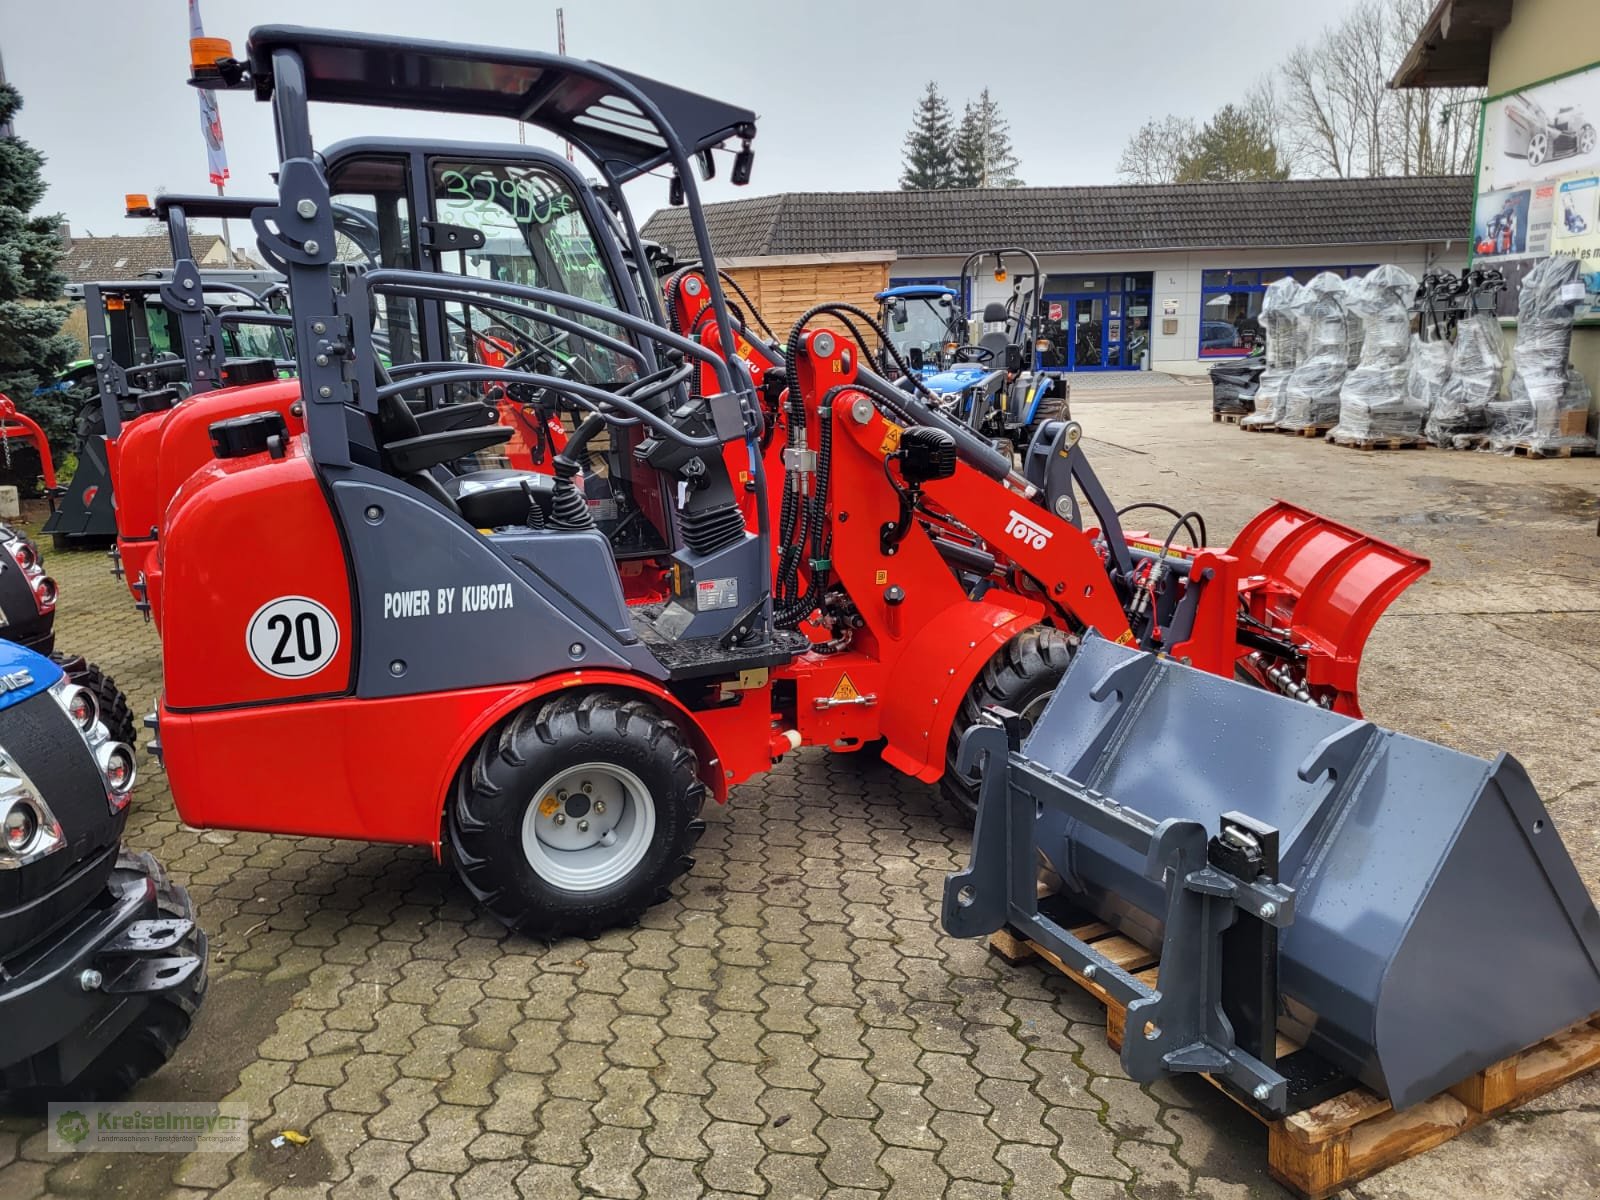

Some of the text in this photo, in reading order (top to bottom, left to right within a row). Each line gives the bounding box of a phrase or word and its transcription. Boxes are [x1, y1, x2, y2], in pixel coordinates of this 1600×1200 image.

[1004, 509, 1054, 550] TOYO
[384, 582, 514, 619] POWER BY KUBOTA
[267, 611, 322, 665] 20
